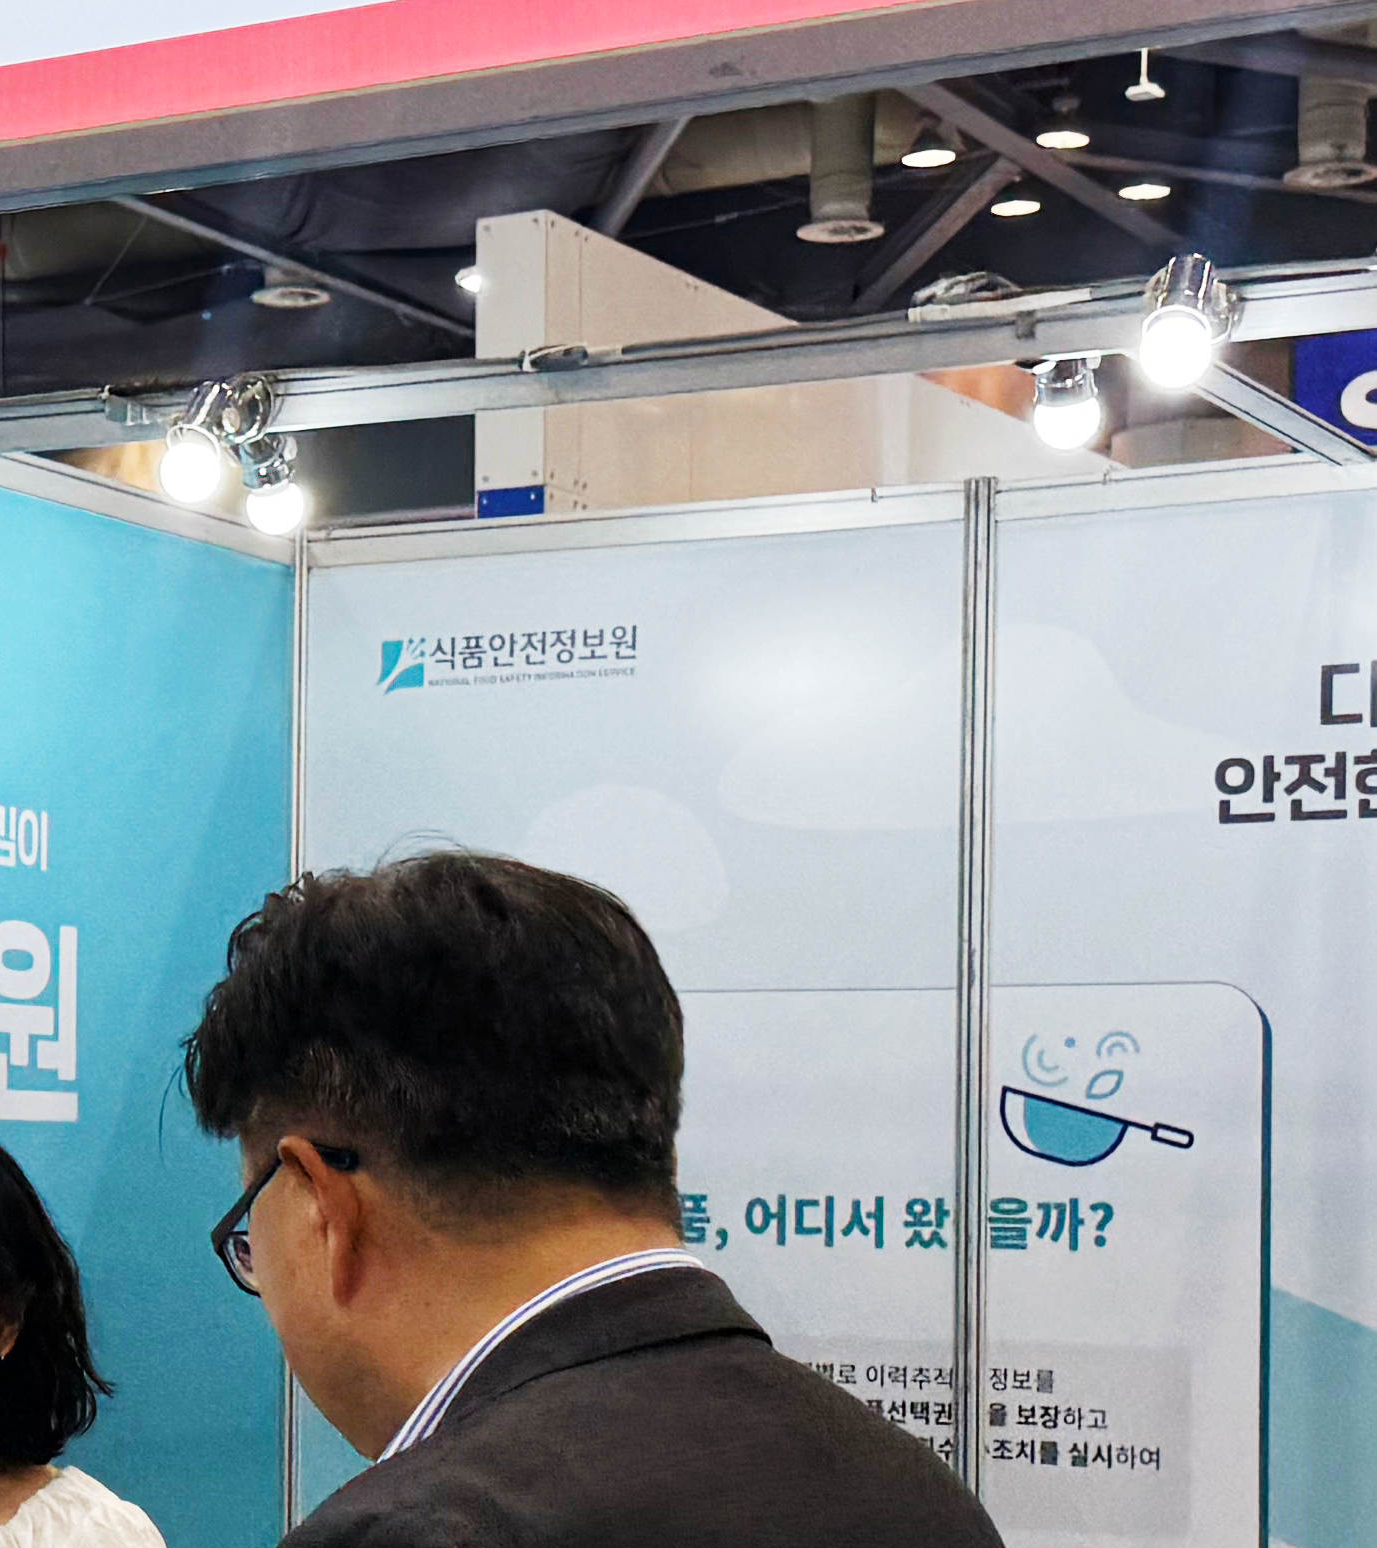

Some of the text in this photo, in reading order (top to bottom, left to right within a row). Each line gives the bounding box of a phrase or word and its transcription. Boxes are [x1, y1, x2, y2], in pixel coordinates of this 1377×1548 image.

[429, 625, 637, 670] 식품안전정보원
[744, 1194, 885, 1249] 어디서
[1016, 1405, 1108, 1430] 보장하고
[1069, 1441, 1161, 1471] 실시하여
